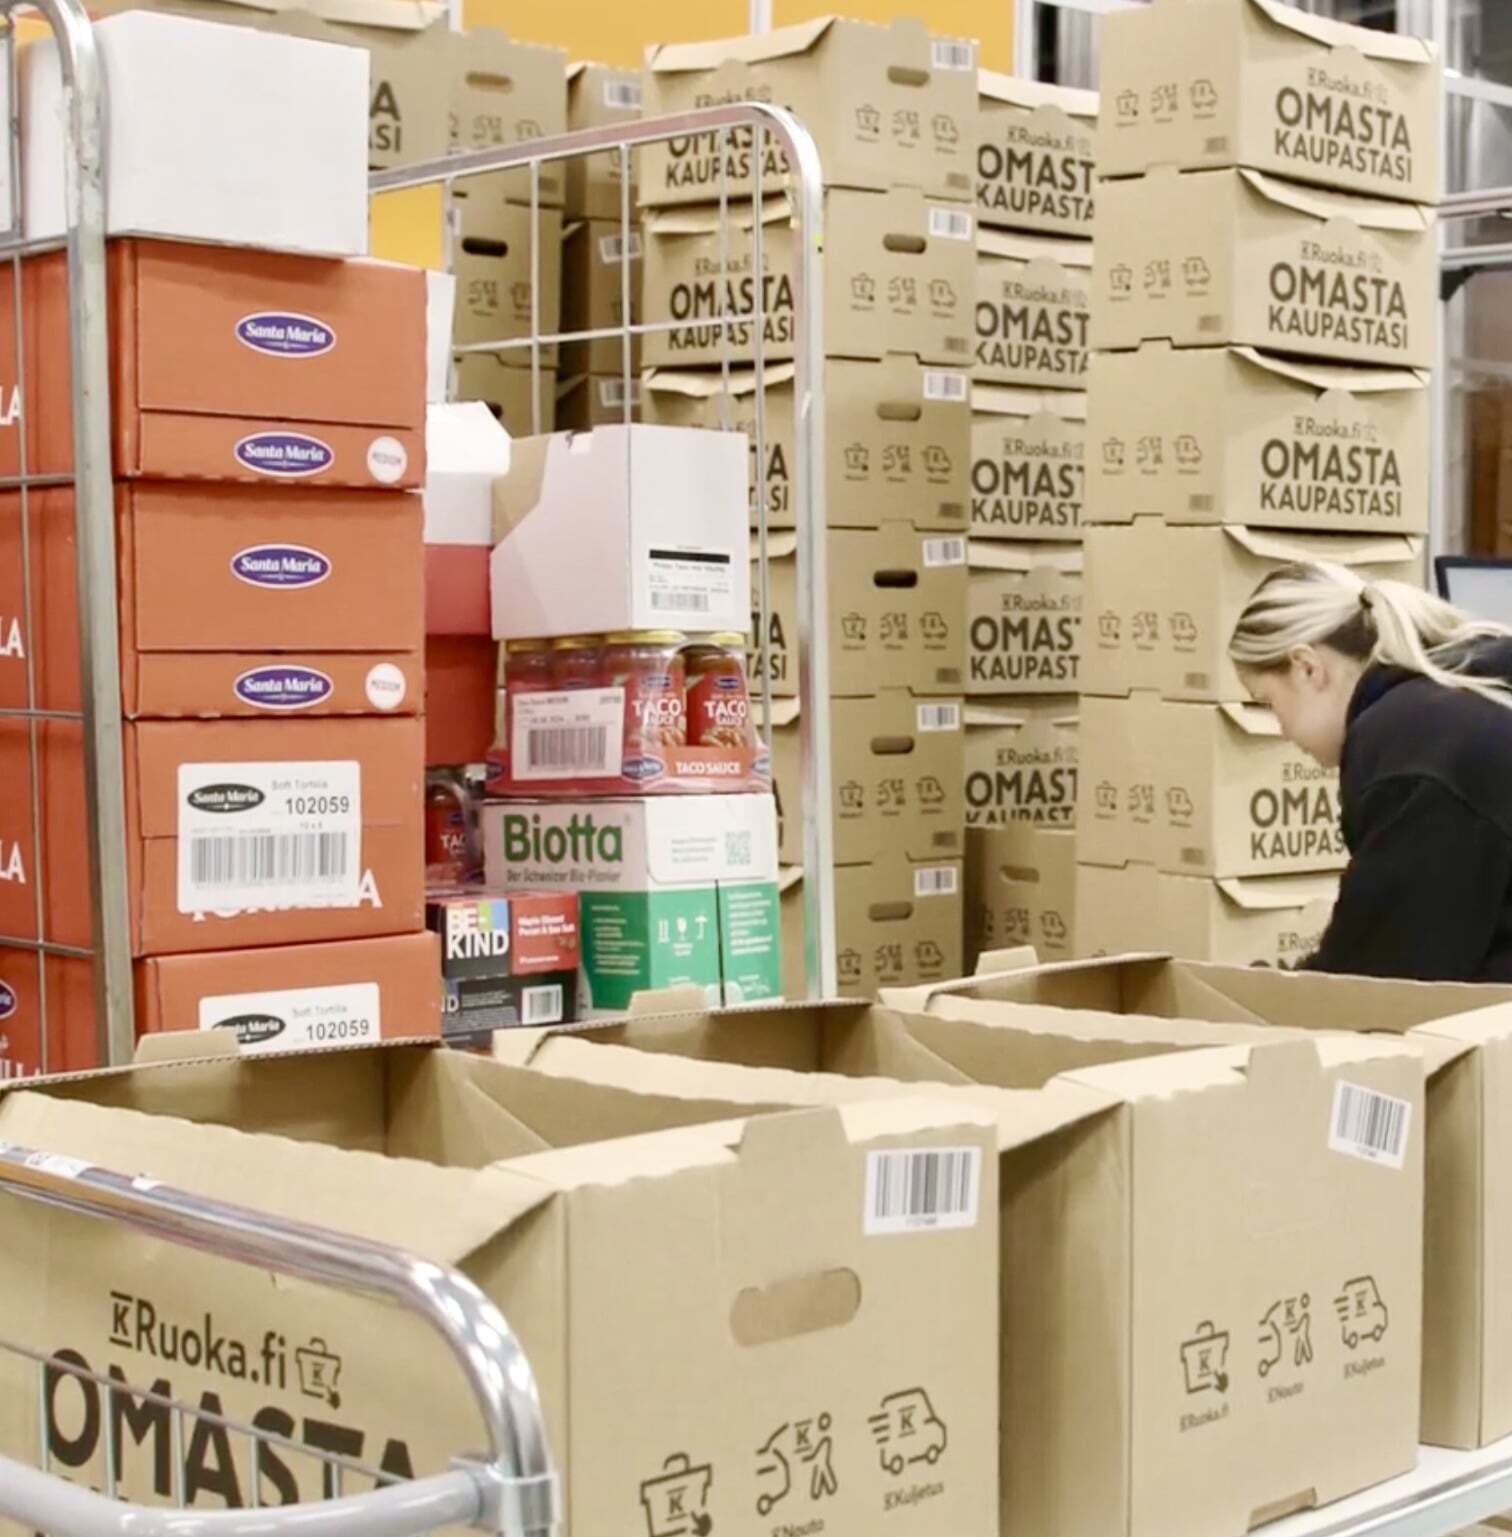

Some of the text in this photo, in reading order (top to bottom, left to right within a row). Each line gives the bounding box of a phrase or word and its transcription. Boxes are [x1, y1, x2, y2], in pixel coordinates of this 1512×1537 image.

[1276, 87, 1411, 152] OMASTA
[978, 145, 1096, 193] OMAST
[1275, 130, 1412, 183] KAUPASTASI
[976, 184, 1095, 221] KAUPASTA
[1269, 262, 1407, 319] OMASTA
[244, 321, 327, 344] Santa Maria
[974, 302, 1090, 347] OMAST
[1268, 304, 1408, 349] KAUPASTASI
[974, 341, 1088, 375] KAUPASTA
[243, 443, 325, 462] Santa Maria
[1261, 439, 1401, 487] OMASTA
[971, 499, 1085, 527] KAUPAST
[1260, 482, 1402, 518] KAUPASTASI
[240, 555, 322, 575] Santa Maria
[970, 616, 1081, 652] OMAS
[970, 654, 1080, 680] KAUPAST
[243, 676, 324, 695] Santa Maria
[631, 698, 682, 717] TACO
[704, 700, 746, 718] TACO
[675, 761, 705, 775] TACO
[706, 761, 742, 774] SAUCE
[193, 789, 260, 804] Santa Maria
[965, 769, 1078, 807] OMAST
[285, 796, 351, 816] 102059
[1250, 787, 1343, 827] OMA
[503, 814, 624, 863] Biotta
[1250, 827, 1346, 860] KAUPAS
[447, 930, 510, 960] KIND
[247, 1018, 280, 1034] Maria
[306, 1019, 370, 1041] 102059
